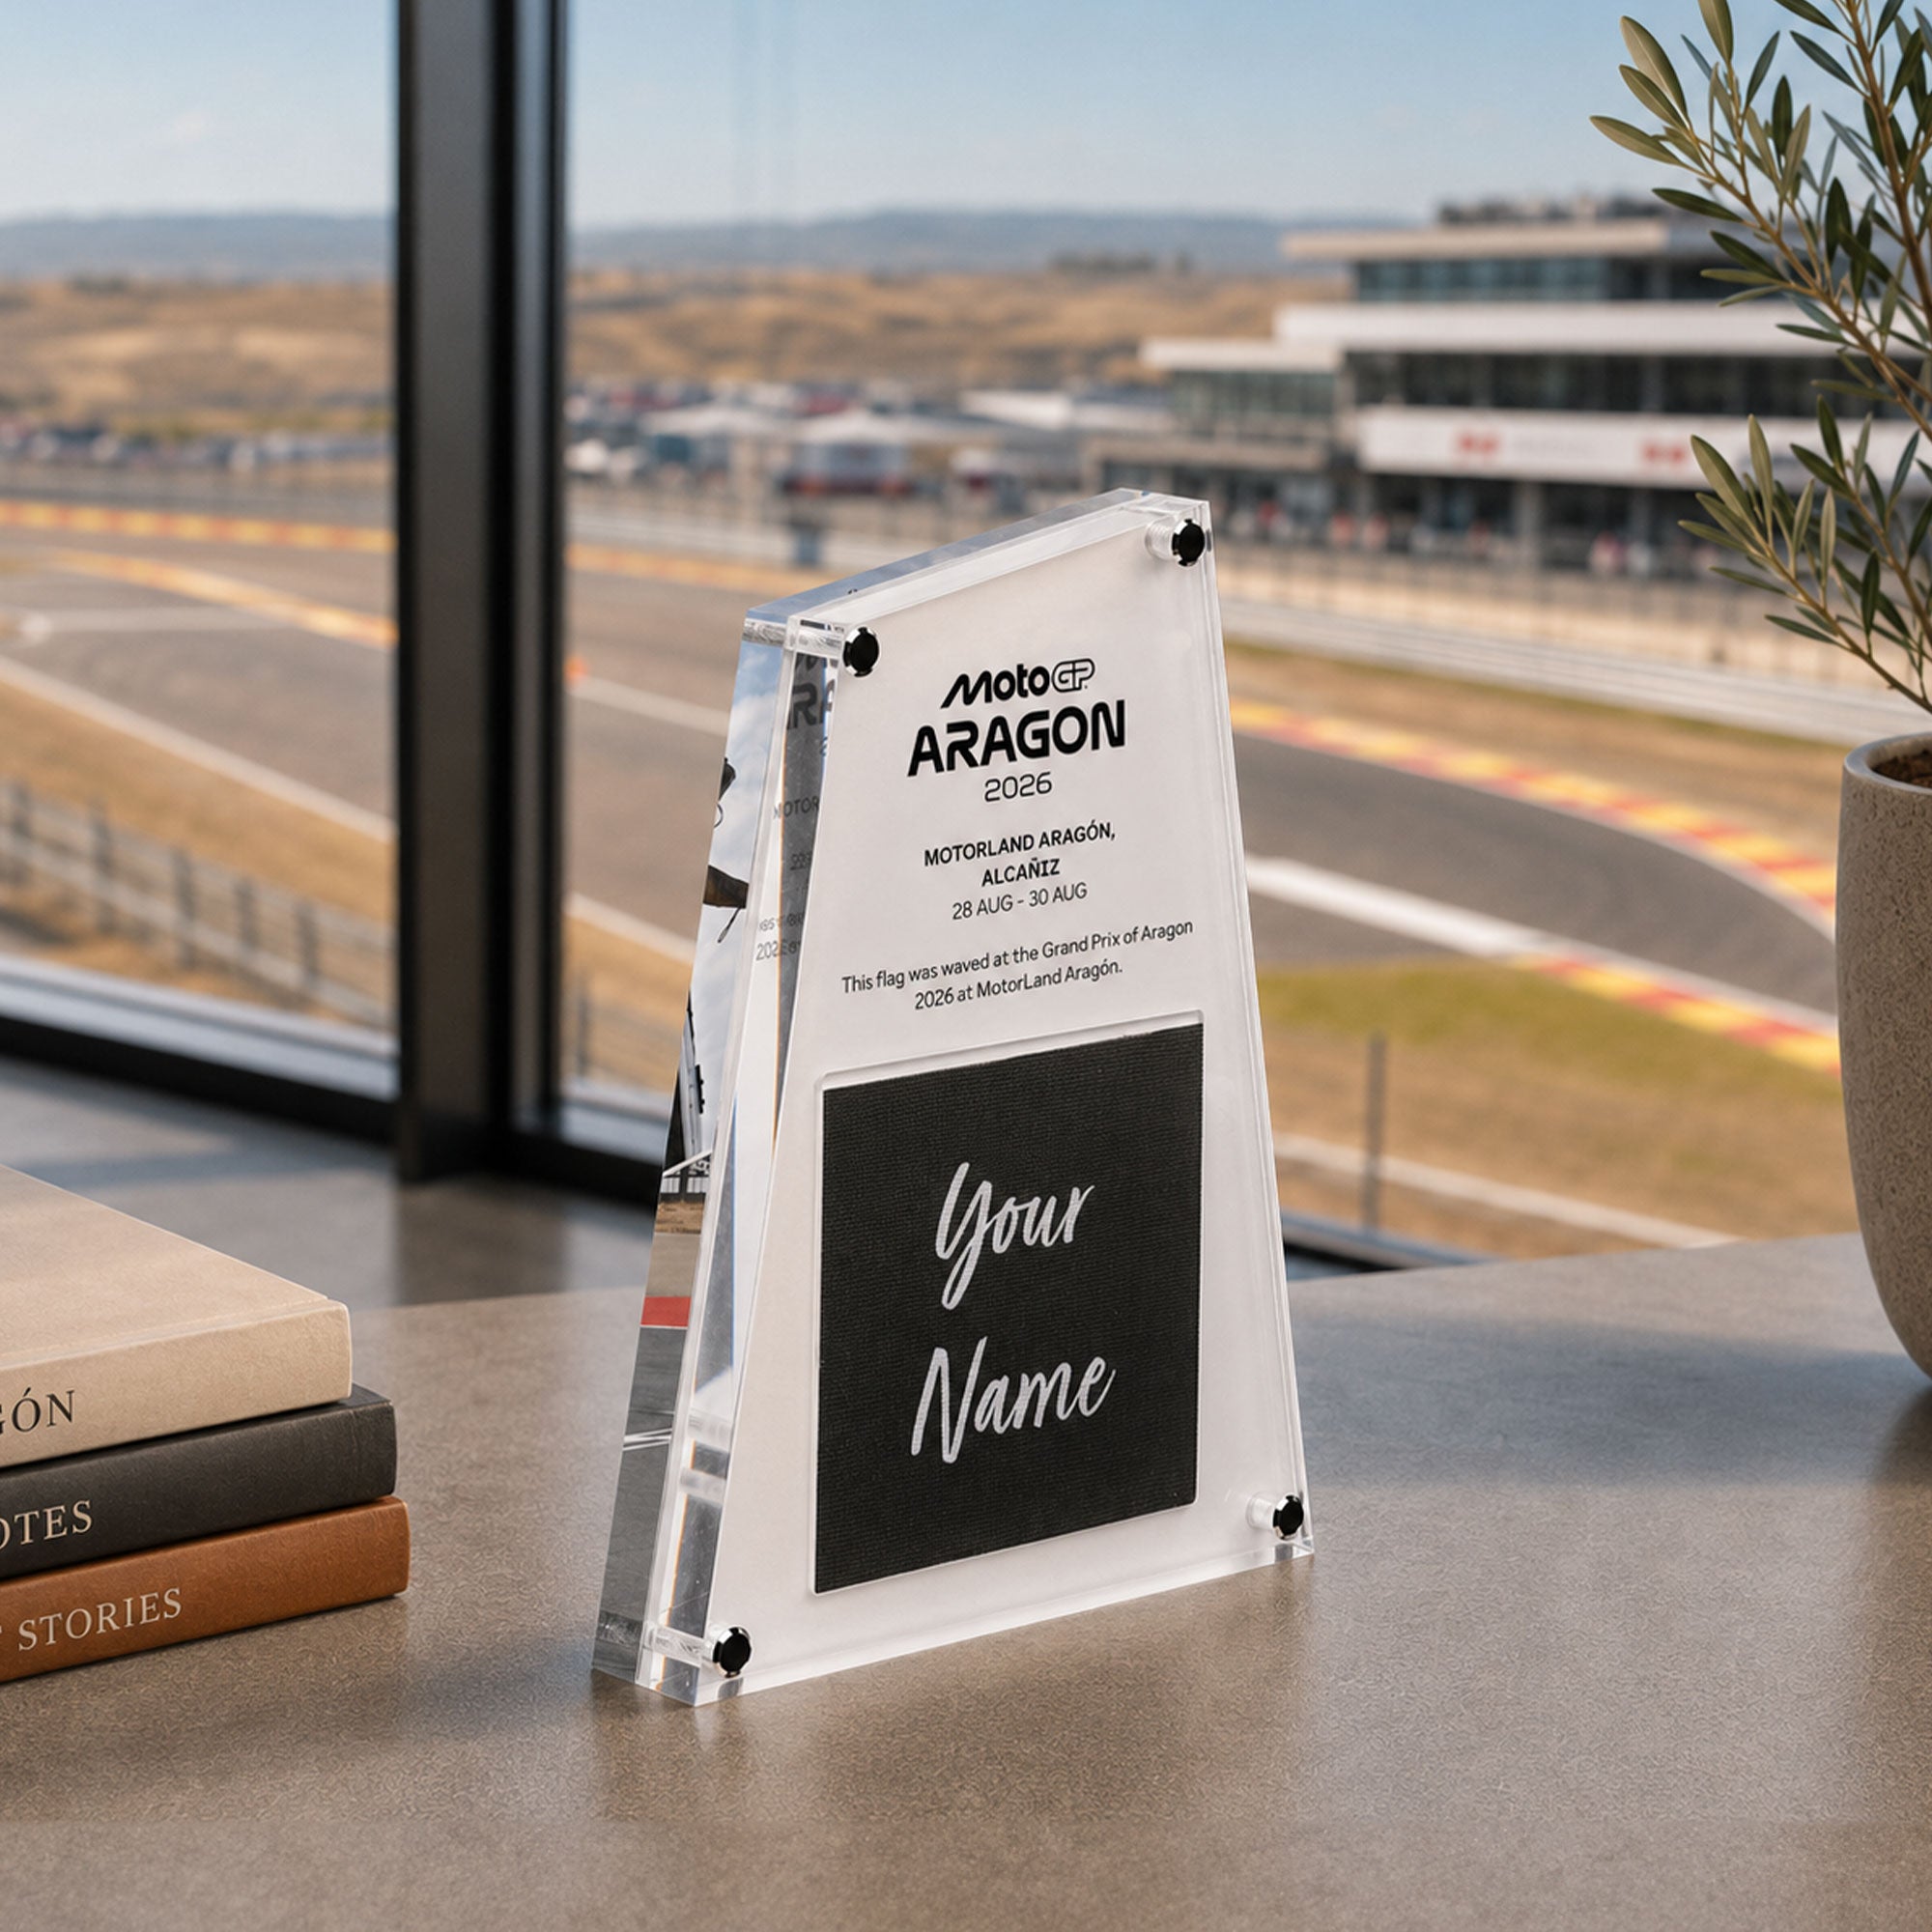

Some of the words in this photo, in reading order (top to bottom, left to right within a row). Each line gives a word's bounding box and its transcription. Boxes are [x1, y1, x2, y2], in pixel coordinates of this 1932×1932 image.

[940, 658, 1096, 710] MotoGP
[906, 698, 1125, 778] ARAGON
[983, 771, 1053, 803] 2026
[923, 834, 1035, 867] MOTORLAND
[1037, 819, 1116, 850] ARAGÓN,
[980, 856, 1061, 888] ALCAÑIZ
[952, 900, 973, 921] 28
[976, 894, 1013, 916] AUG
[1029, 888, 1049, 907] 30
[1052, 881, 1088, 903] AUG
[841, 974, 874, 994] This
[875, 970, 905, 990] flag
[908, 966, 939, 982] was
[940, 952, 990, 977] waved
[992, 951, 1009, 968] at
[1011, 946, 1039, 964] the
[1041, 933, 1089, 958] Grand
[1091, 932, 1121, 951] Prix
[1122, 925, 1139, 945] of
[1140, 921, 1193, 942] Aragon
[915, 986, 955, 1010] 2026
[956, 985, 974, 1003] at
[977, 967, 1063, 998] MotorLand
[1064, 958, 1123, 982] Aragón.
[935, 1162, 1095, 1310] Your
[0, 1387, 75, 1435] ÓN
[911, 1336, 1116, 1464] Name
[17, 1587, 182, 1651] STORIES
